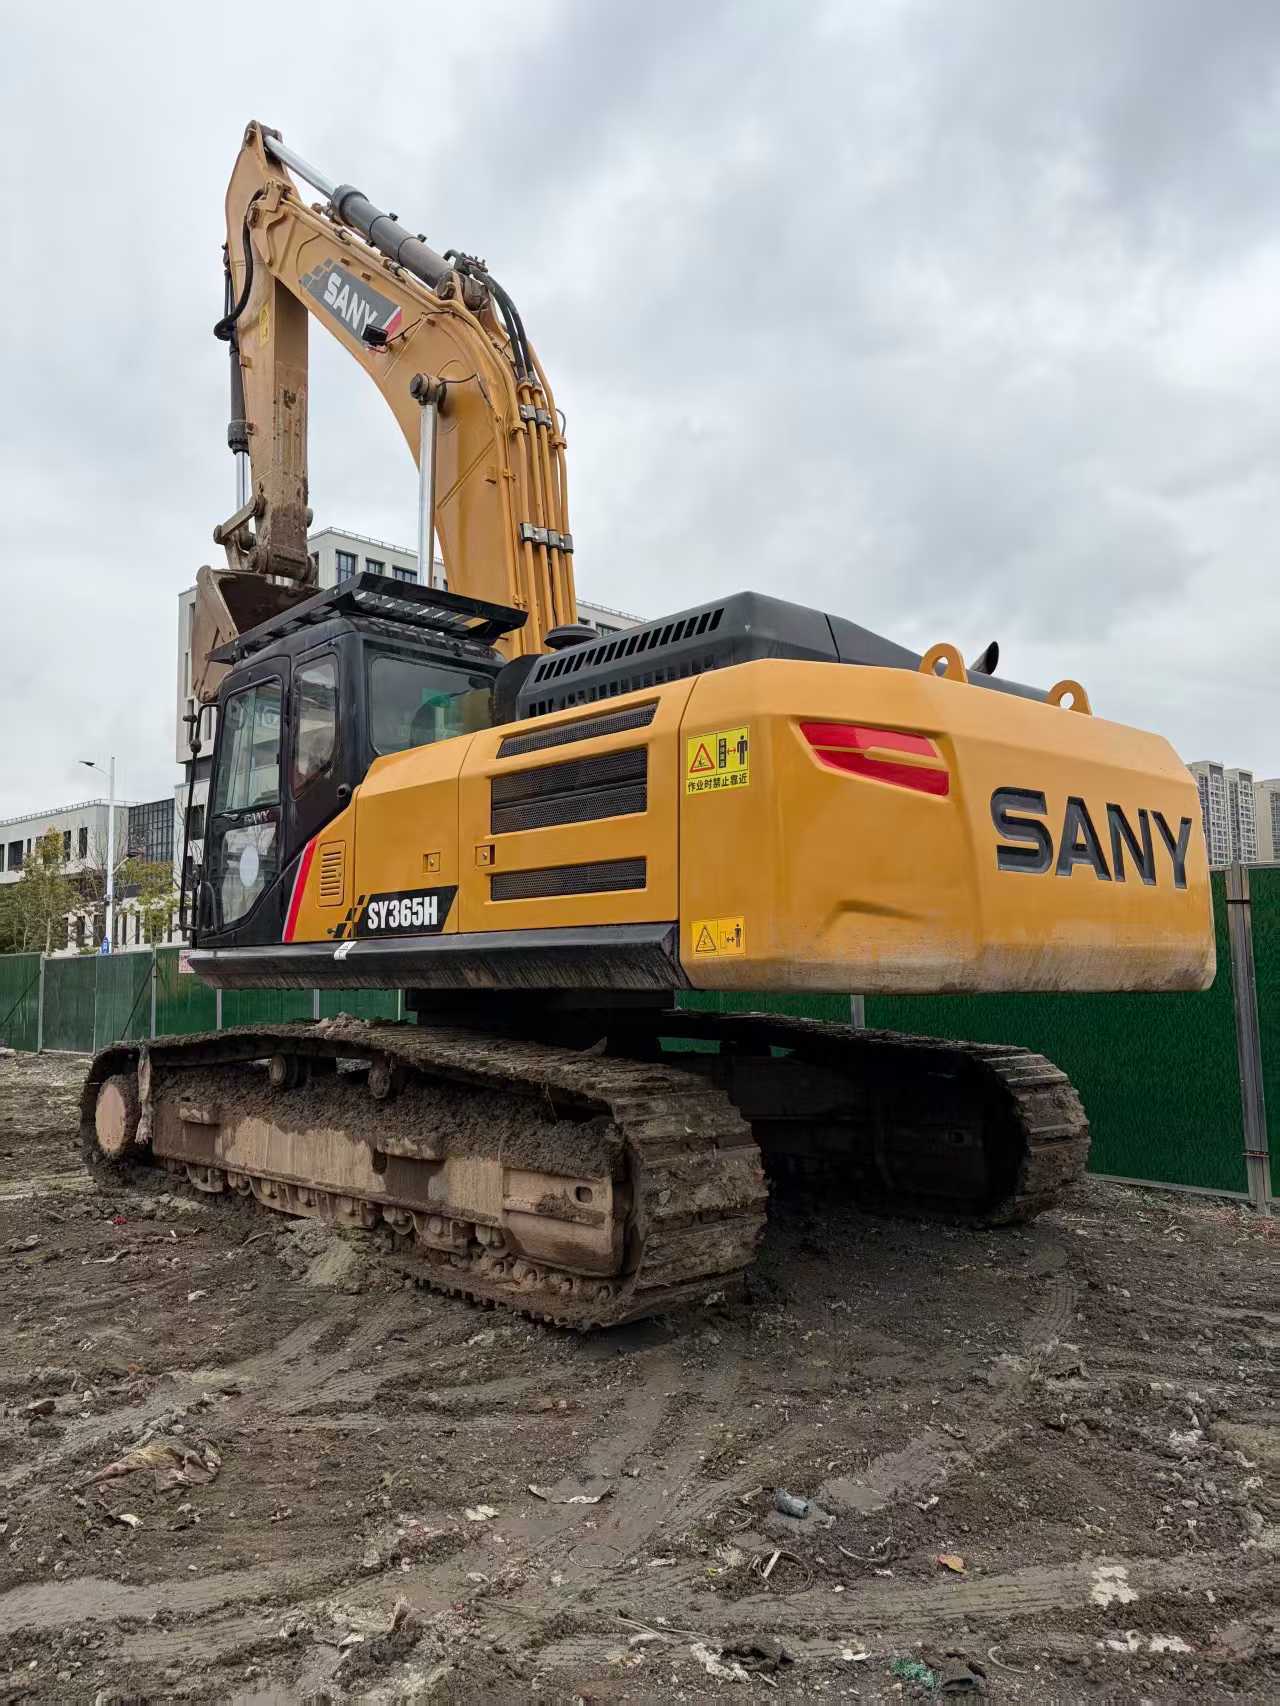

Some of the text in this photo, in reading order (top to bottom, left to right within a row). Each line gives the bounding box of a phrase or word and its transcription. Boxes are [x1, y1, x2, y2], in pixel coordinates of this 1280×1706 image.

[323, 272, 378, 336] SANY
[688, 773, 748, 792] 作业时禁止靠近
[990, 786, 1193, 889] SANY
[367, 896, 438, 930] SY365H
